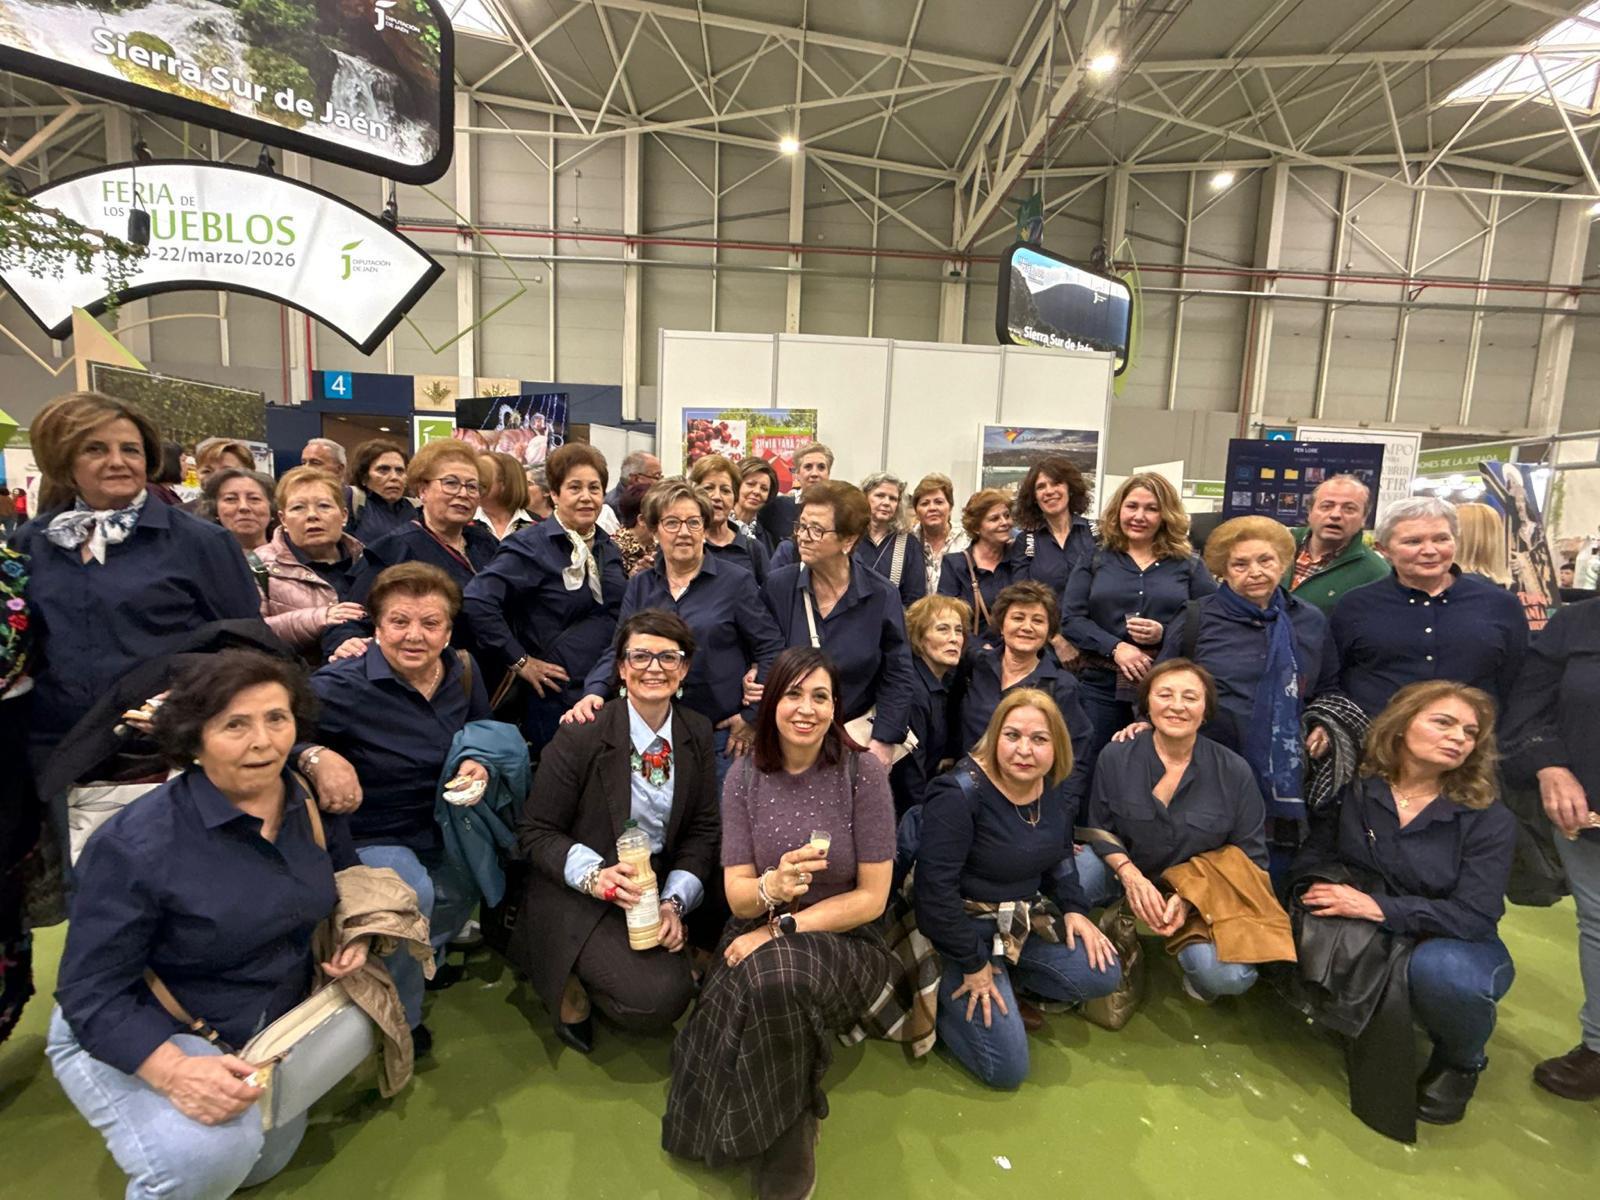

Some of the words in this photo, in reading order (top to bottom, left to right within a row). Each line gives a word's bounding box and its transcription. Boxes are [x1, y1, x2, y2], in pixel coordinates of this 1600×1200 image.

[93, 27, 201, 84] Sierra
[210, 65, 267, 103] Sur
[273, 87, 315, 119] de
[319, 101, 387, 140] Jaén
[102, 180, 175, 205] FERIA
[180, 195, 195, 206] DE
[103, 206, 125, 217] LOS
[150, 208, 297, 246] UEBLOS
[1023, 325, 1049, 344] Sierra
[1050, 333, 1065, 348] Sur
[1064, 337, 1076, 350] de
[331, 374, 346, 395] 4
